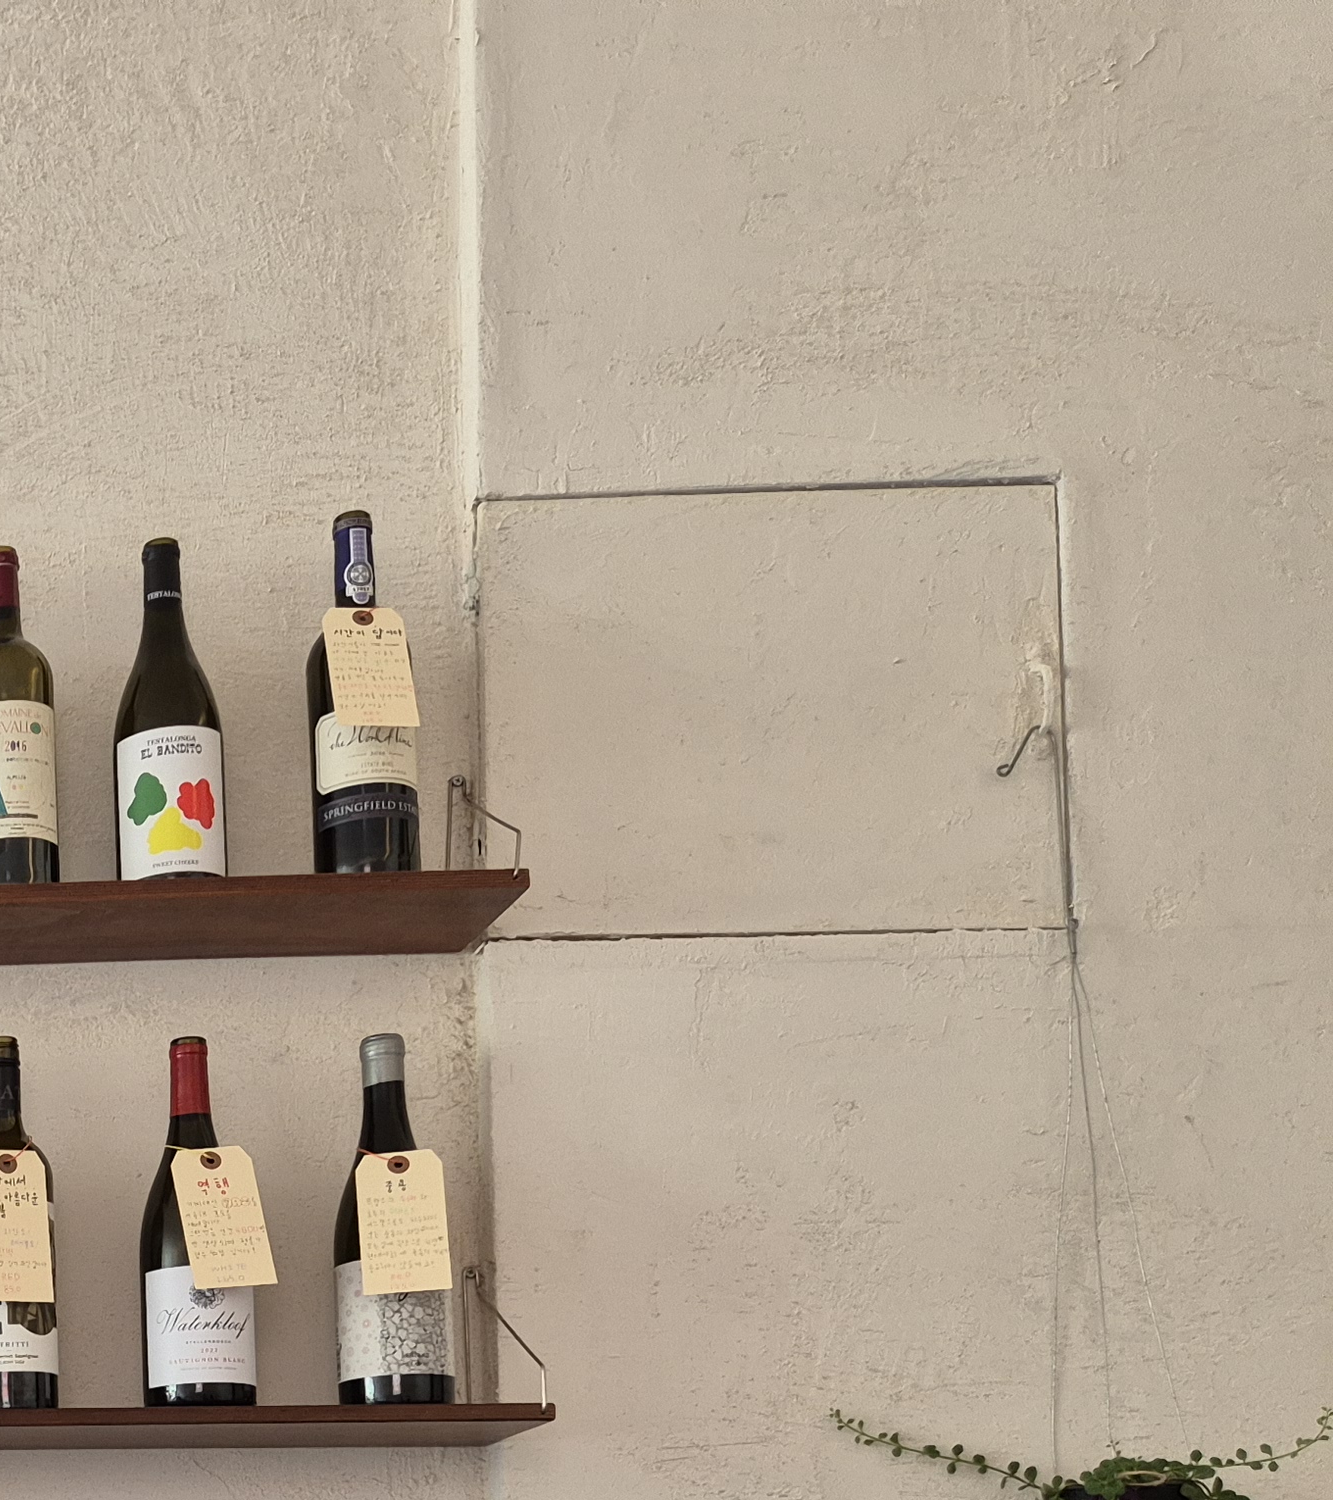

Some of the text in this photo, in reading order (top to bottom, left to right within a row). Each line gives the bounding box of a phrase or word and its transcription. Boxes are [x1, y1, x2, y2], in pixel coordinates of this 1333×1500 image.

[140, 743, 203, 760] EL BANDITO
[323, 800, 396, 821] SPRINGFIELD
[4, 1191, 38, 1206] 아름다운
[157, 1307, 250, 1340] Waterkloof
